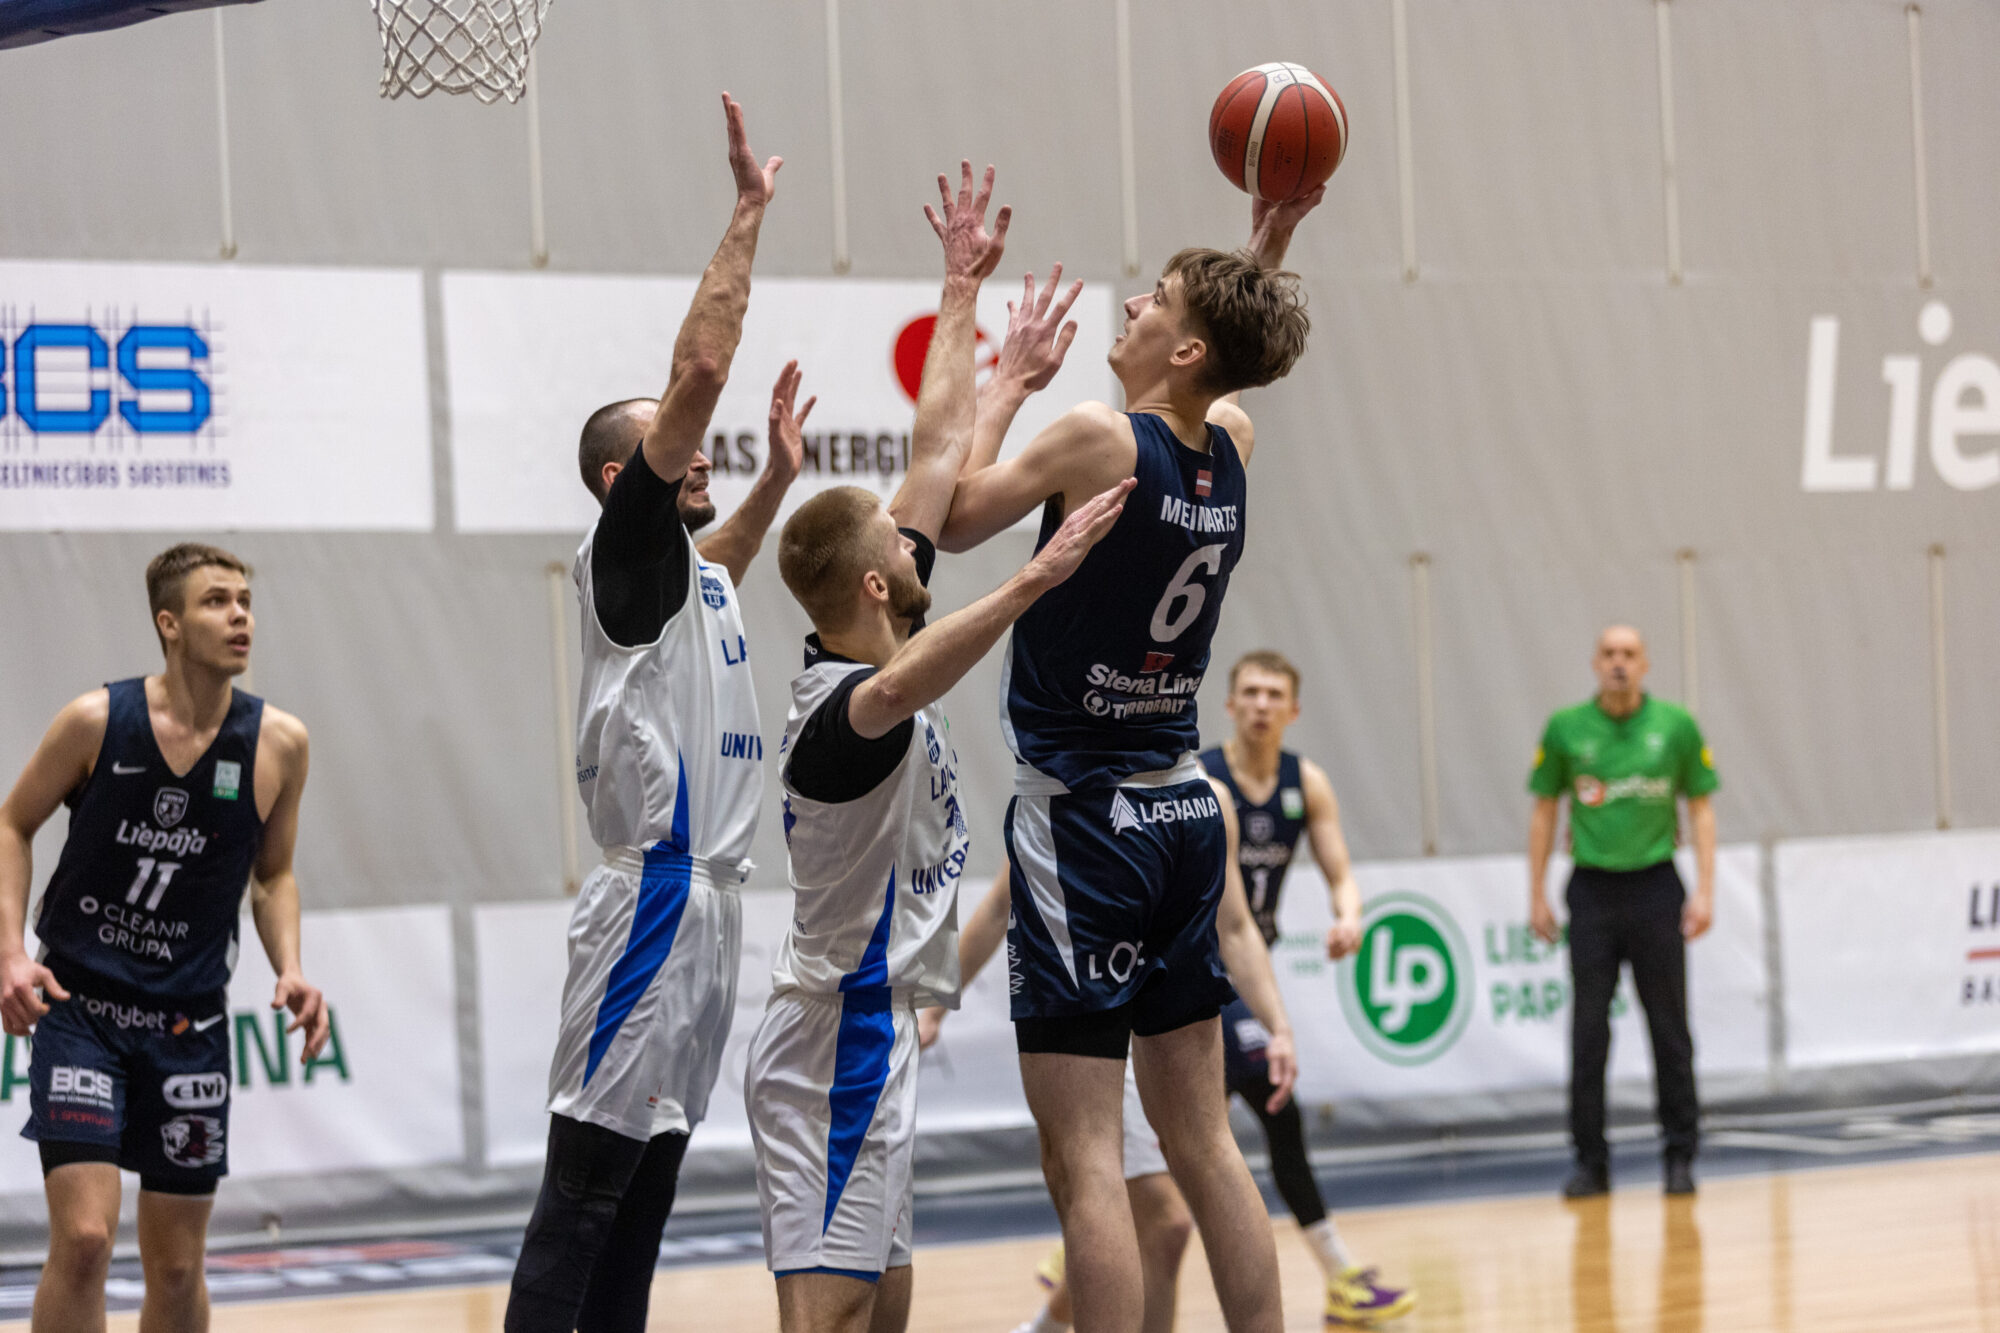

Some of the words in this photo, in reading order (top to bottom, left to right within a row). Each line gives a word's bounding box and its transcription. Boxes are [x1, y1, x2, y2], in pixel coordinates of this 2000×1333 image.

[0, 324, 212, 433] CS
[1160, 494, 1238, 533] MEINARTS
[1149, 543, 1228, 643] 6
[1086, 663, 1157, 695] Stena
[1158, 672, 1201, 695] Line
[116, 818, 208, 858] Liepāja
[125, 857, 183, 912] 11
[103, 902, 190, 940] CLEANR
[98, 922, 173, 963] GRUPA
[79, 993, 167, 1030] onybet
